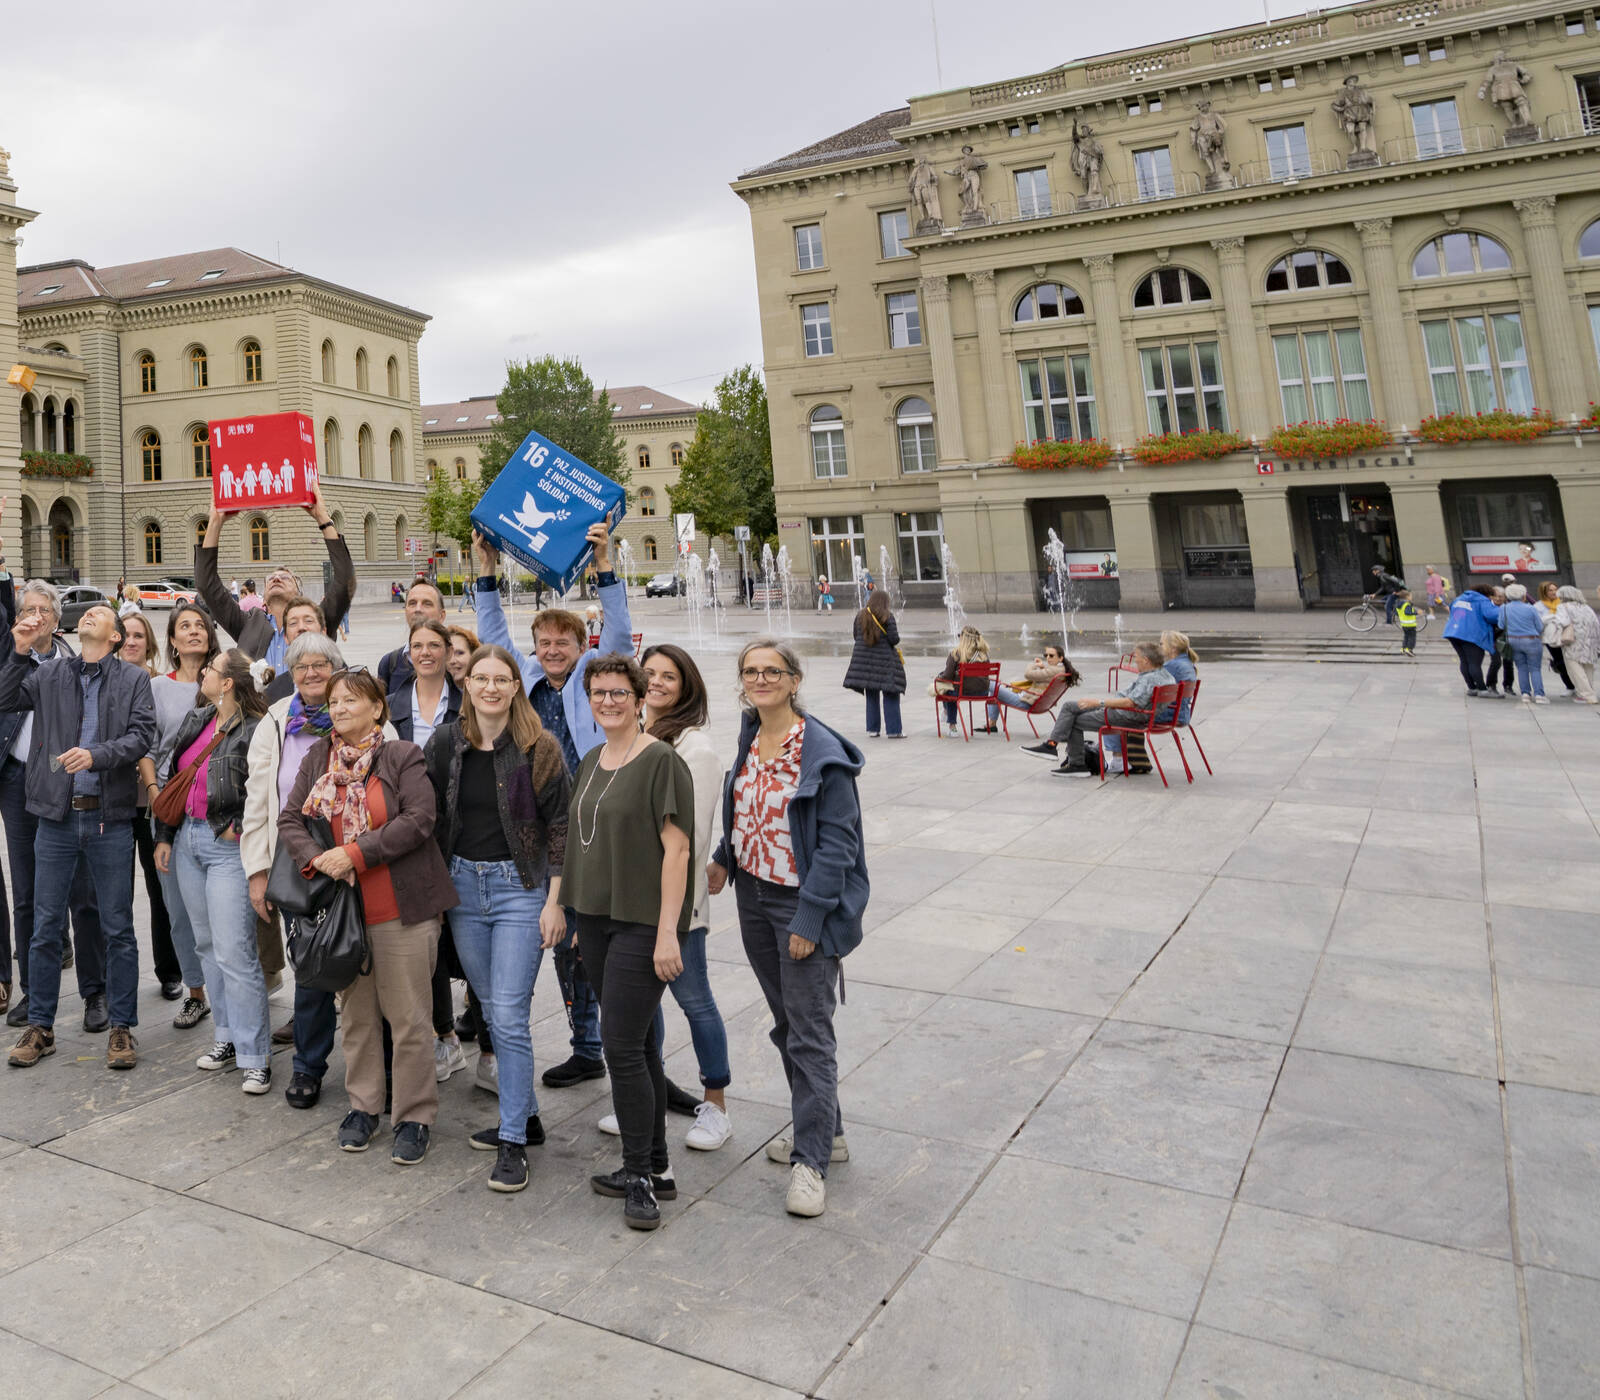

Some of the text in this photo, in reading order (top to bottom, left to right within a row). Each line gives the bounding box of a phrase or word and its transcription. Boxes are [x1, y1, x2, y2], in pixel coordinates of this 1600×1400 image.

[213, 426, 222, 448] 1
[522, 441, 603, 495] 16 PAZ, JUSTICIA
[1358, 457, 1415, 469] BCBE
[537, 478, 570, 504] SÓLIDAS
[544, 467, 554, 478] E
[550, 471, 606, 511] INSTITUCIONES
